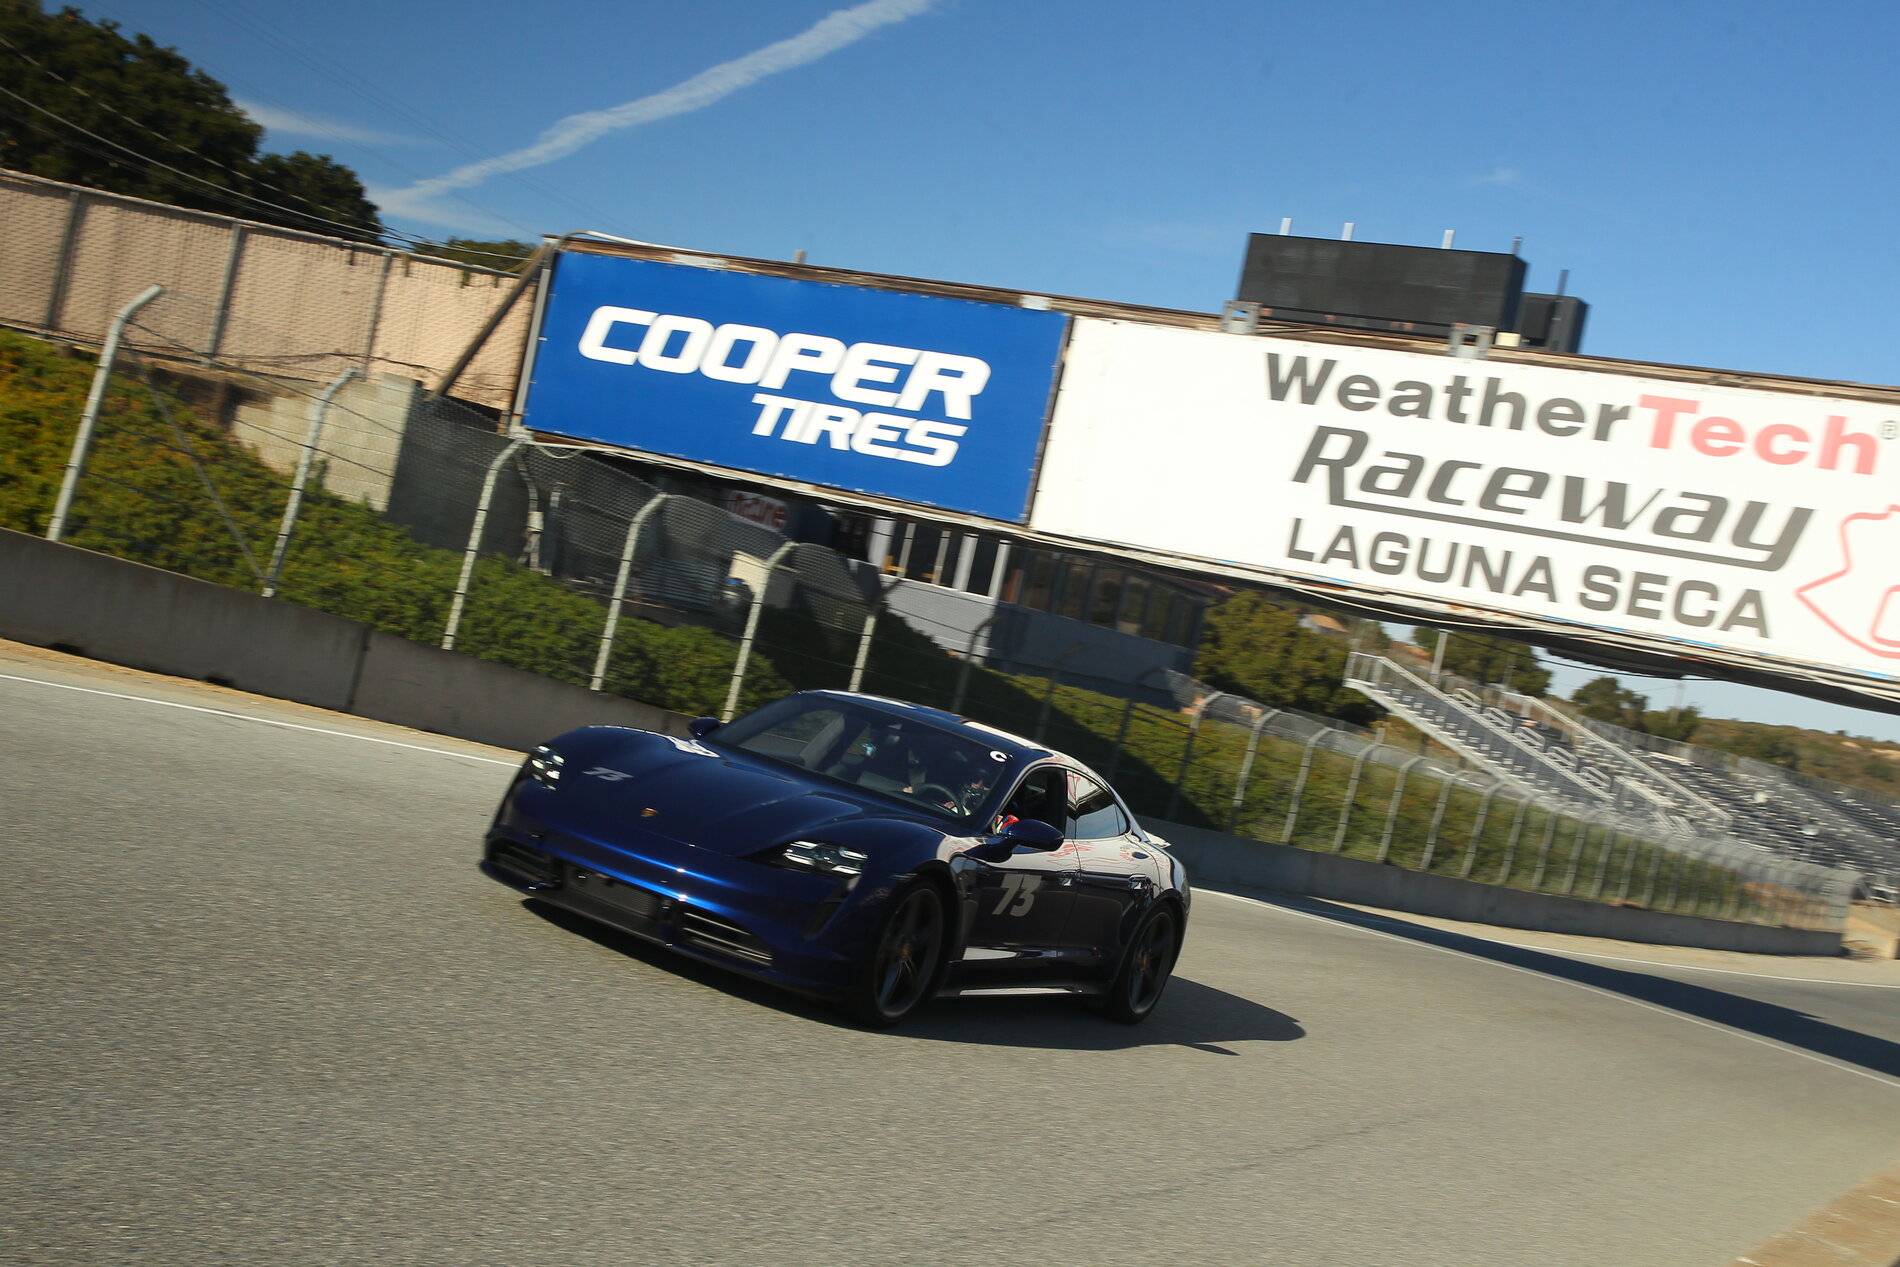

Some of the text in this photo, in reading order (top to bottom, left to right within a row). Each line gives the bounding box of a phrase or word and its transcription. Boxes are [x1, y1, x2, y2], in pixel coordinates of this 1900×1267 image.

[578, 305, 991, 419] COOPER
[1266, 352, 1878, 475] WeatherTech
[752, 393, 968, 466] TIRES
[1293, 425, 1814, 572] Raceway
[1287, 518, 1770, 639] LAGUNA SECA
[992, 873, 1042, 917] 73
